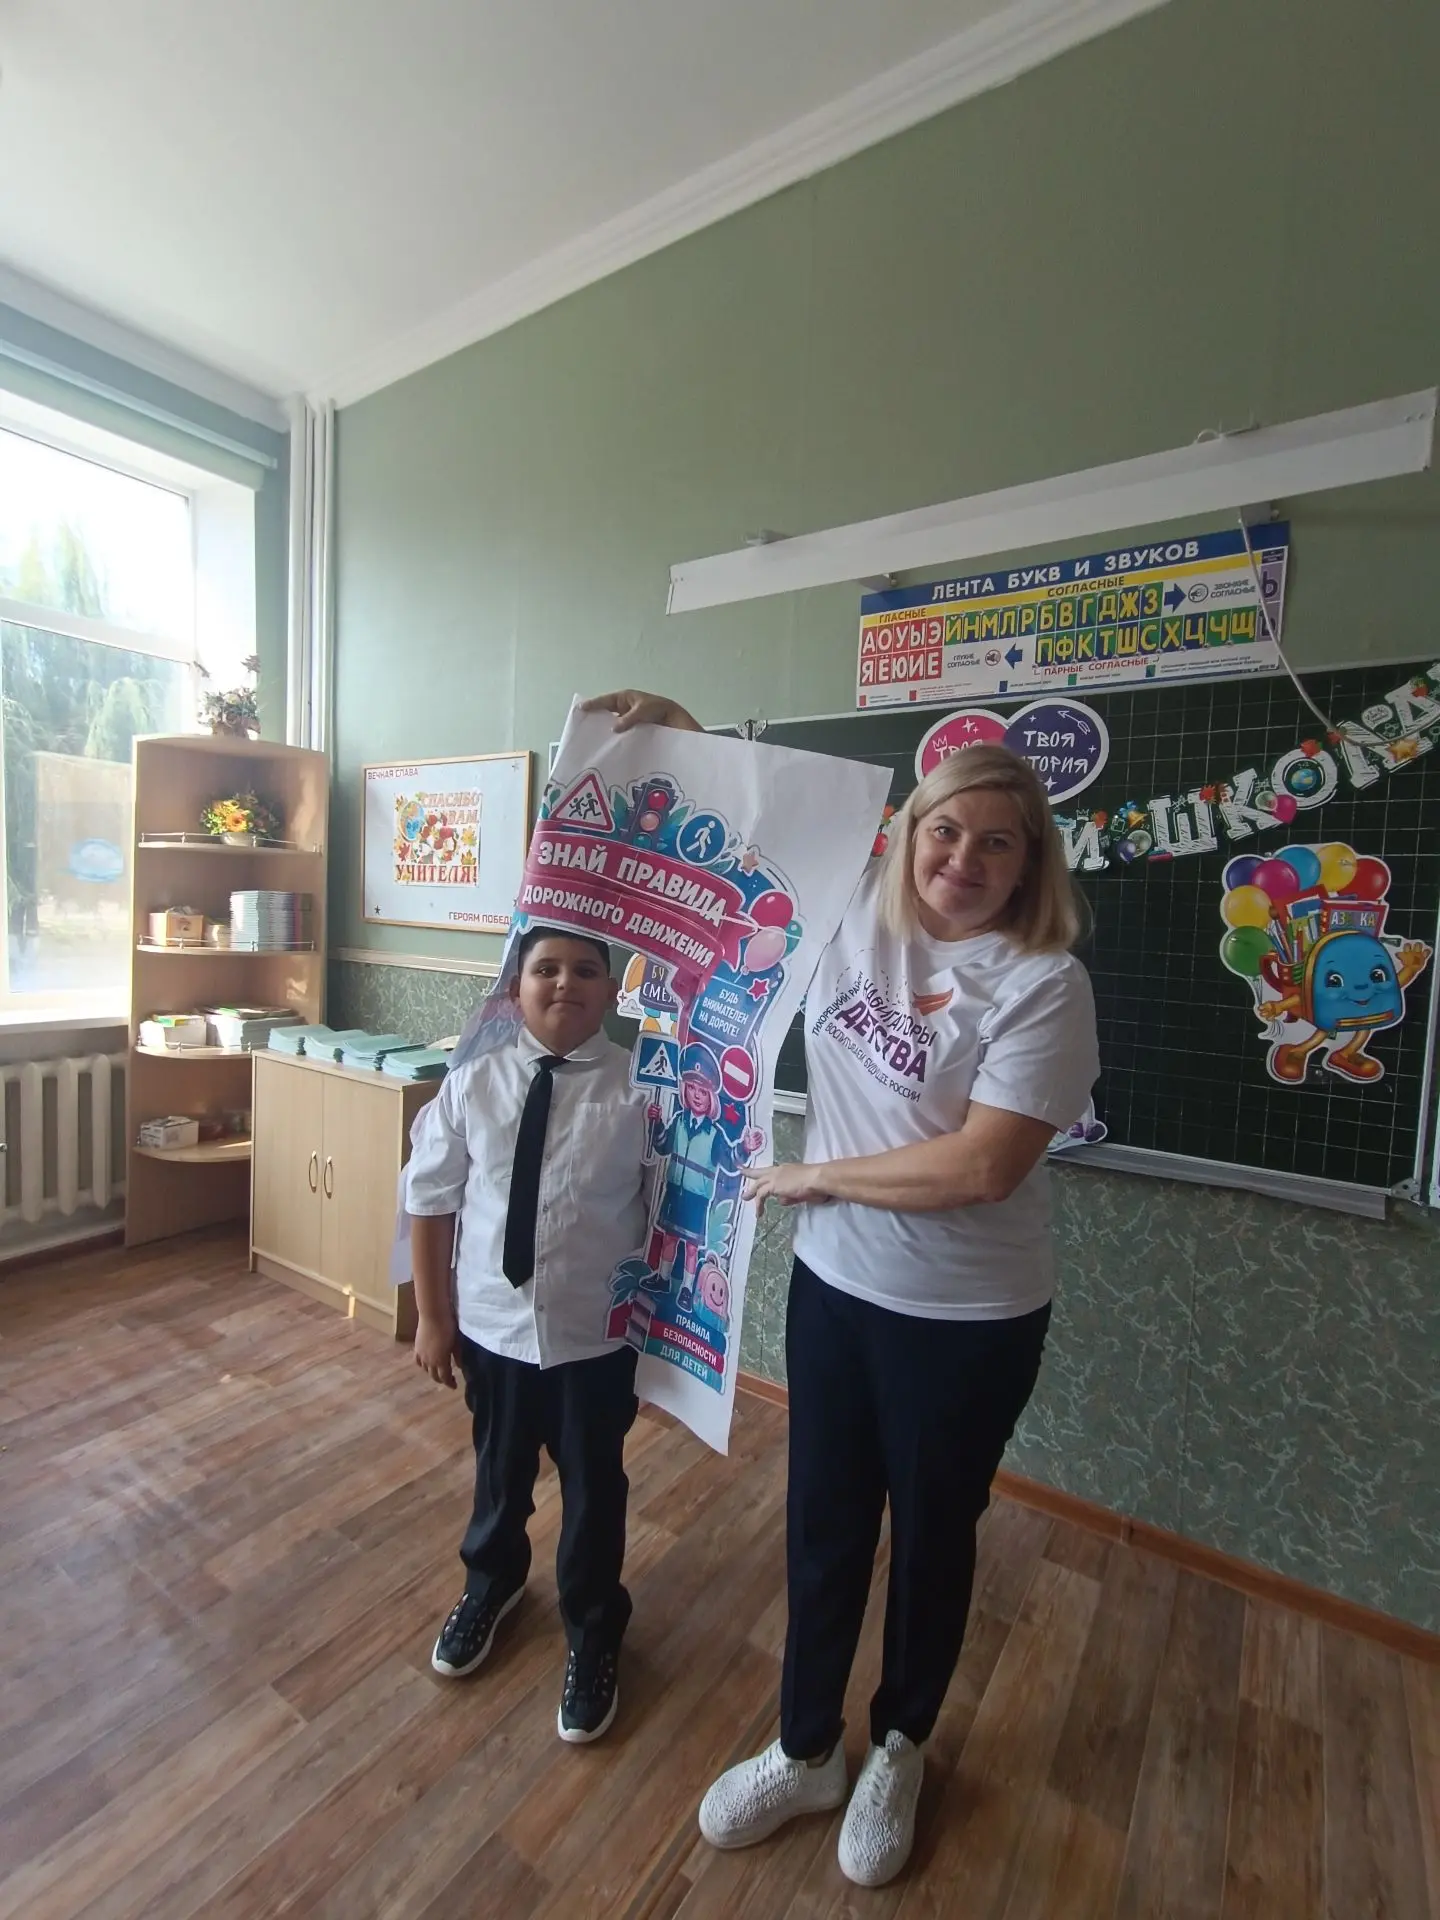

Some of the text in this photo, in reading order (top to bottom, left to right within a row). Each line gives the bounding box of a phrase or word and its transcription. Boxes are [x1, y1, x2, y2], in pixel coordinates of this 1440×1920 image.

[931, 541, 1199, 600] ЛЕНТА БУКВ И ЗВУКОВ
[1047, 576, 1125, 598] СОГЛАСНЫЕ
[878, 608, 926, 624] ГЛАСНЫЕ
[1044, 664, 1084, 676] ПАРНЫЕ
[1088, 657, 1149, 671] СОГЛАСНЫЕ
[1023, 730, 1076, 748] ТВОЯ
[367, 767, 419, 780] ВЕЧНАЯ СЛАВА
[1021, 755, 1088, 775] ТОРИЯ
[395, 864, 477, 885] УЧИТЕЛЯ!
[537, 841, 728, 927] ЗНАЙ ПРАВИЛА
[448, 911, 480, 923] ГЕРОЯМ
[521, 884, 716, 971] ДОРОЖНОГО ДВИЖЕНИЯ
[718, 988, 740, 1004] БУДЬ
[702, 997, 749, 1025] ВНИМАТЕЛЕН
[812, 992, 851, 1037] ТИХОРЕЦКИЙ
[698, 1010, 740, 1038] НА ДОРОГЕ!
[888, 1079, 922, 1103] РОССИИ
[675, 1314, 711, 1343] ПРАВИЛА
[663, 1327, 718, 1366] БЕЗОПАСНОСТИ
[660, 1344, 709, 1381] ДЛЯ ДЕТЕЙ
